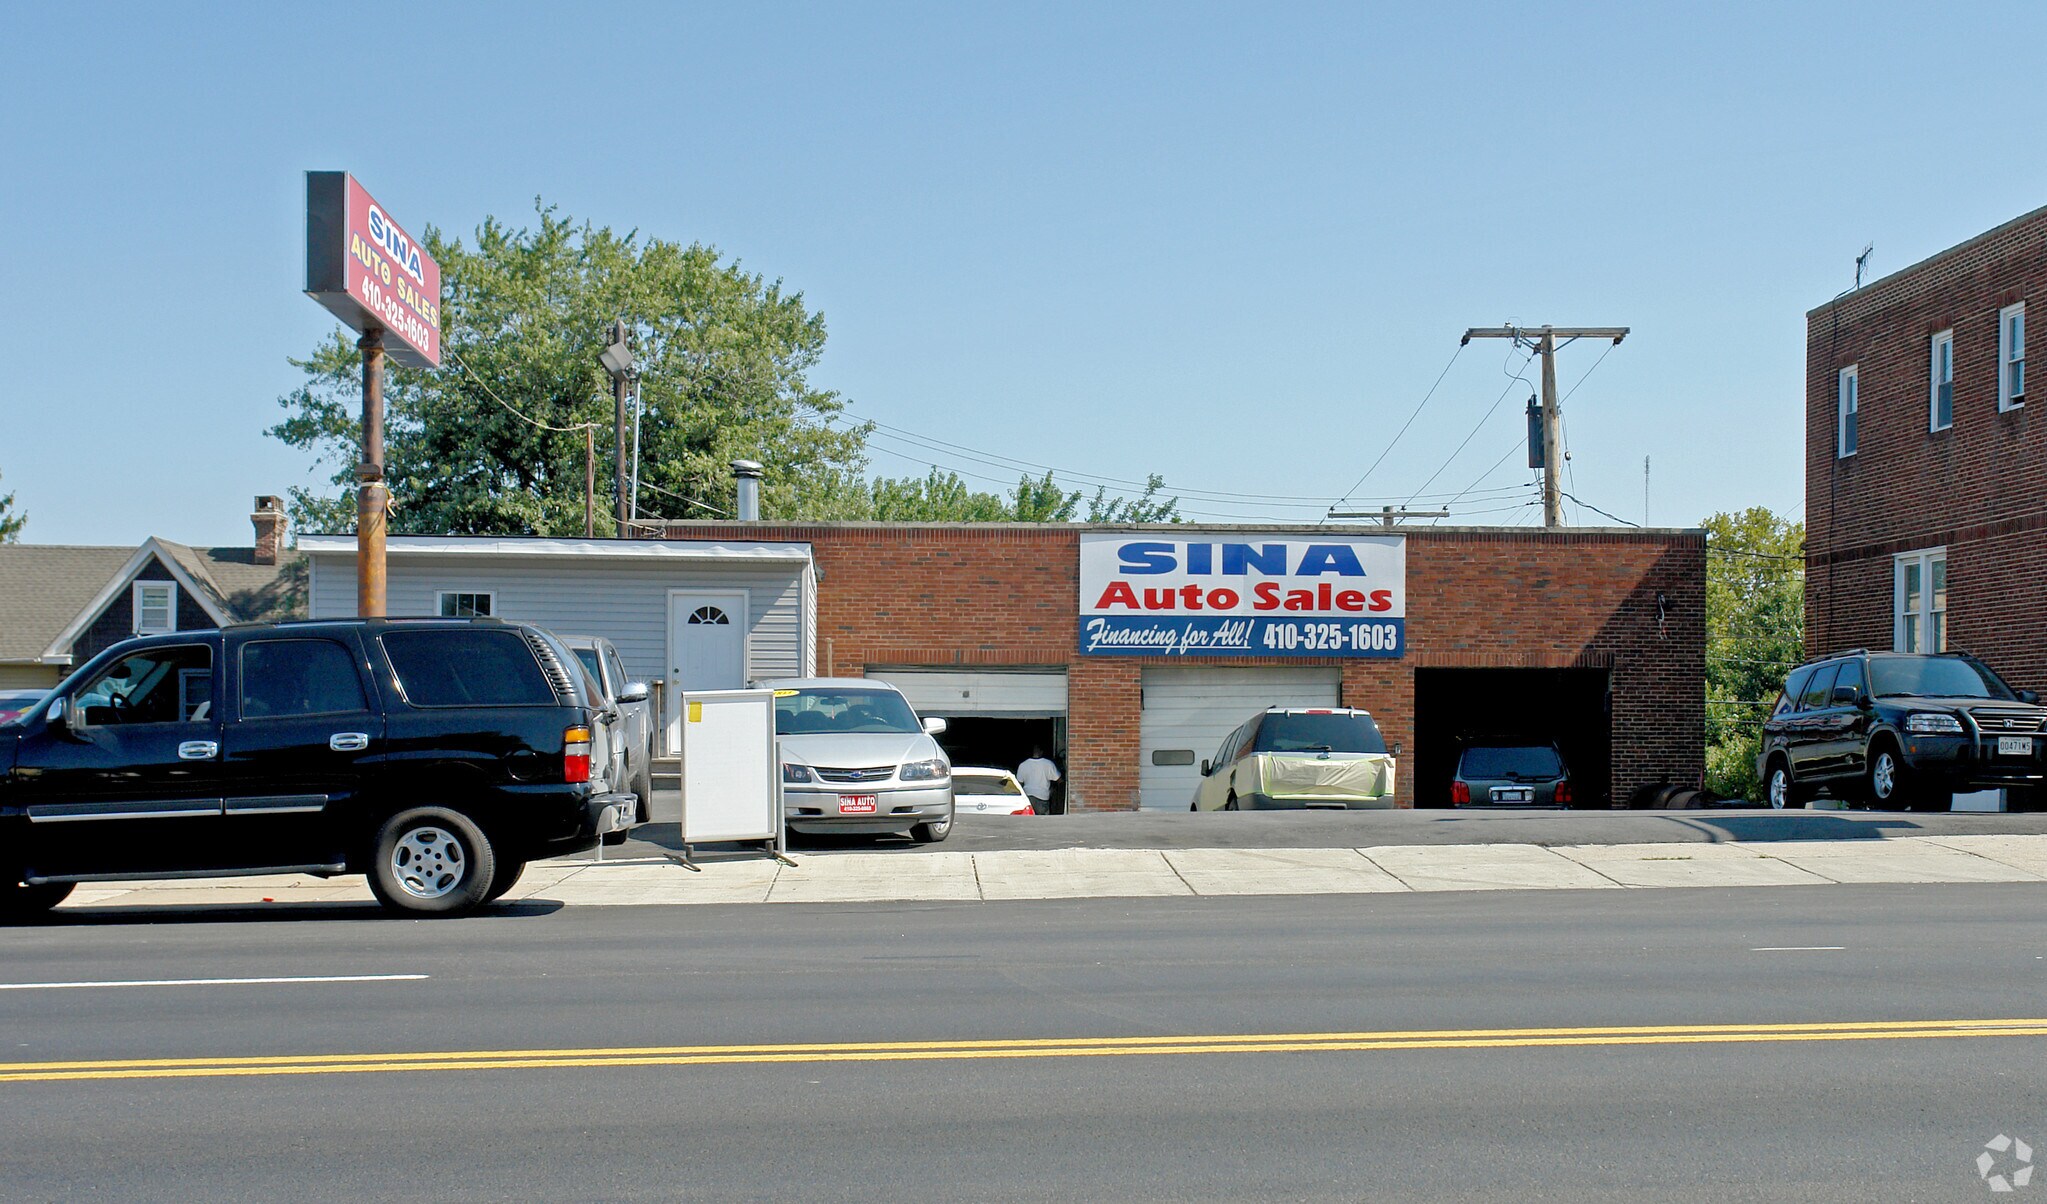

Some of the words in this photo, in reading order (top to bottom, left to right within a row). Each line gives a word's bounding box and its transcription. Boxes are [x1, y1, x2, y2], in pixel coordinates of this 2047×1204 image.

[368, 204, 424, 287] SINA
[350, 232, 392, 287] AUTO
[396, 274, 439, 329] SALES
[361, 275, 429, 352] 410-325-1603
[1117, 542, 1367, 577] SINA
[1094, 581, 1240, 610] Auto
[1252, 582, 1393, 612] Sales
[1086, 618, 1178, 654] Financing
[1178, 622, 1210, 655] for
[1208, 619, 1255, 648] All!
[1263, 623, 1397, 650] 410-325-1603
[840, 796, 856, 806] SINA
[857, 796, 875, 806] AUTO
